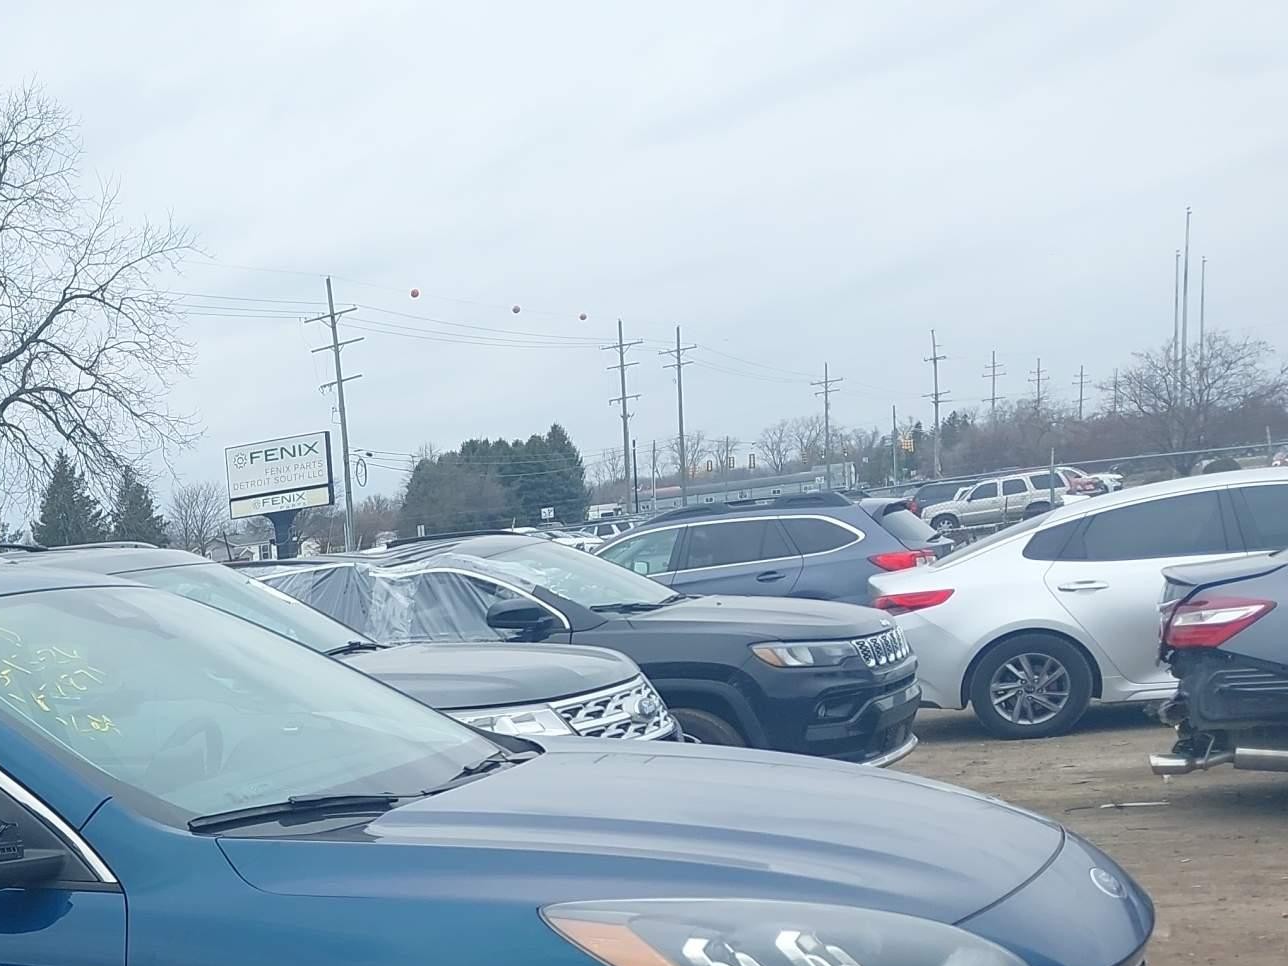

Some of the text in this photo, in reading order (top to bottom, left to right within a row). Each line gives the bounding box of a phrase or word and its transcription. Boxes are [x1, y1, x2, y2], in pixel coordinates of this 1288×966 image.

[250, 442, 319, 464] FENIX
[264, 460, 324, 476] FENIX PARTS
[233, 469, 324, 491] DETROIT SOUTH LLC
[263, 493, 306, 507] FENIX
